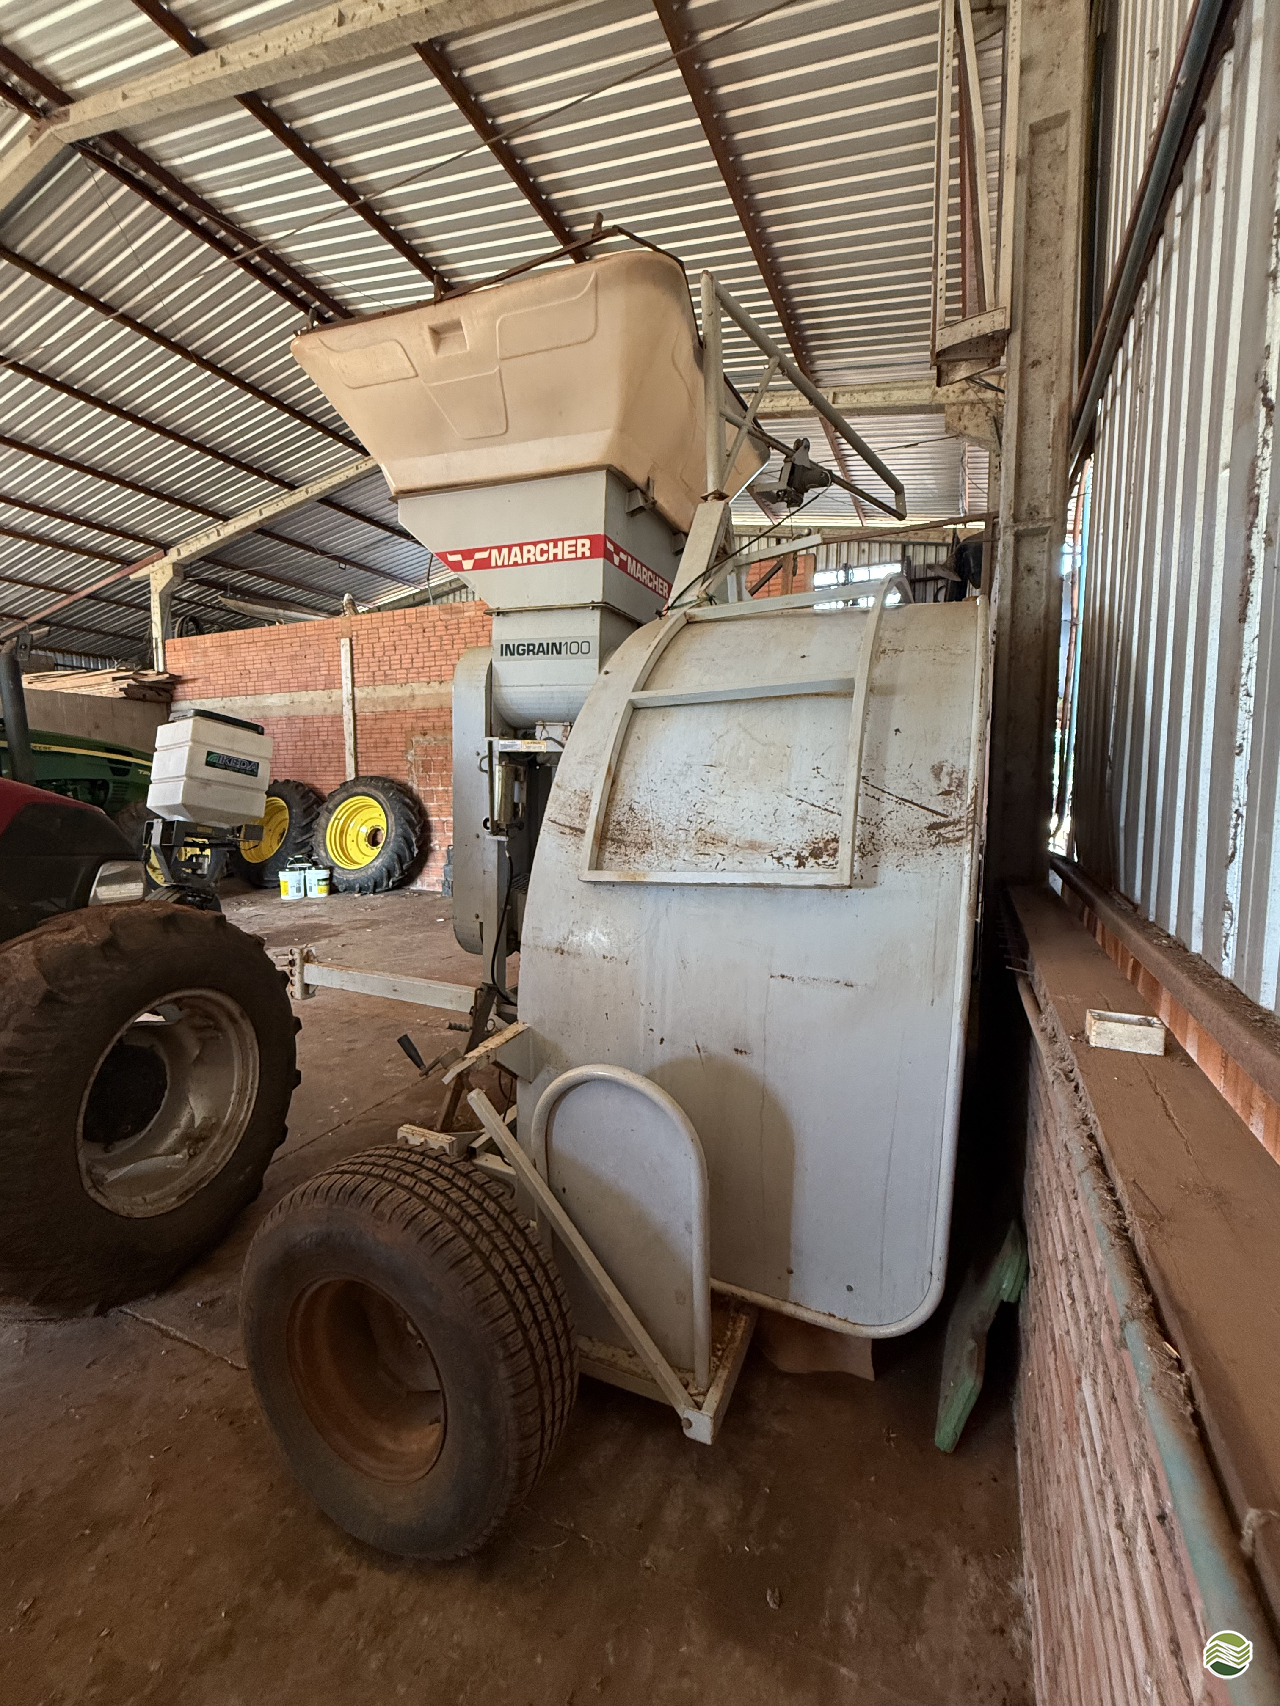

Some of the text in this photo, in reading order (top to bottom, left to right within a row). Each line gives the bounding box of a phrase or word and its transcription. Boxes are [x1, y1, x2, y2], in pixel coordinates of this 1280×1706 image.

[490, 538, 591, 567] MARCHER
[627, 555, 669, 599] MARCHER
[218, 754, 258, 772] IKEDA
